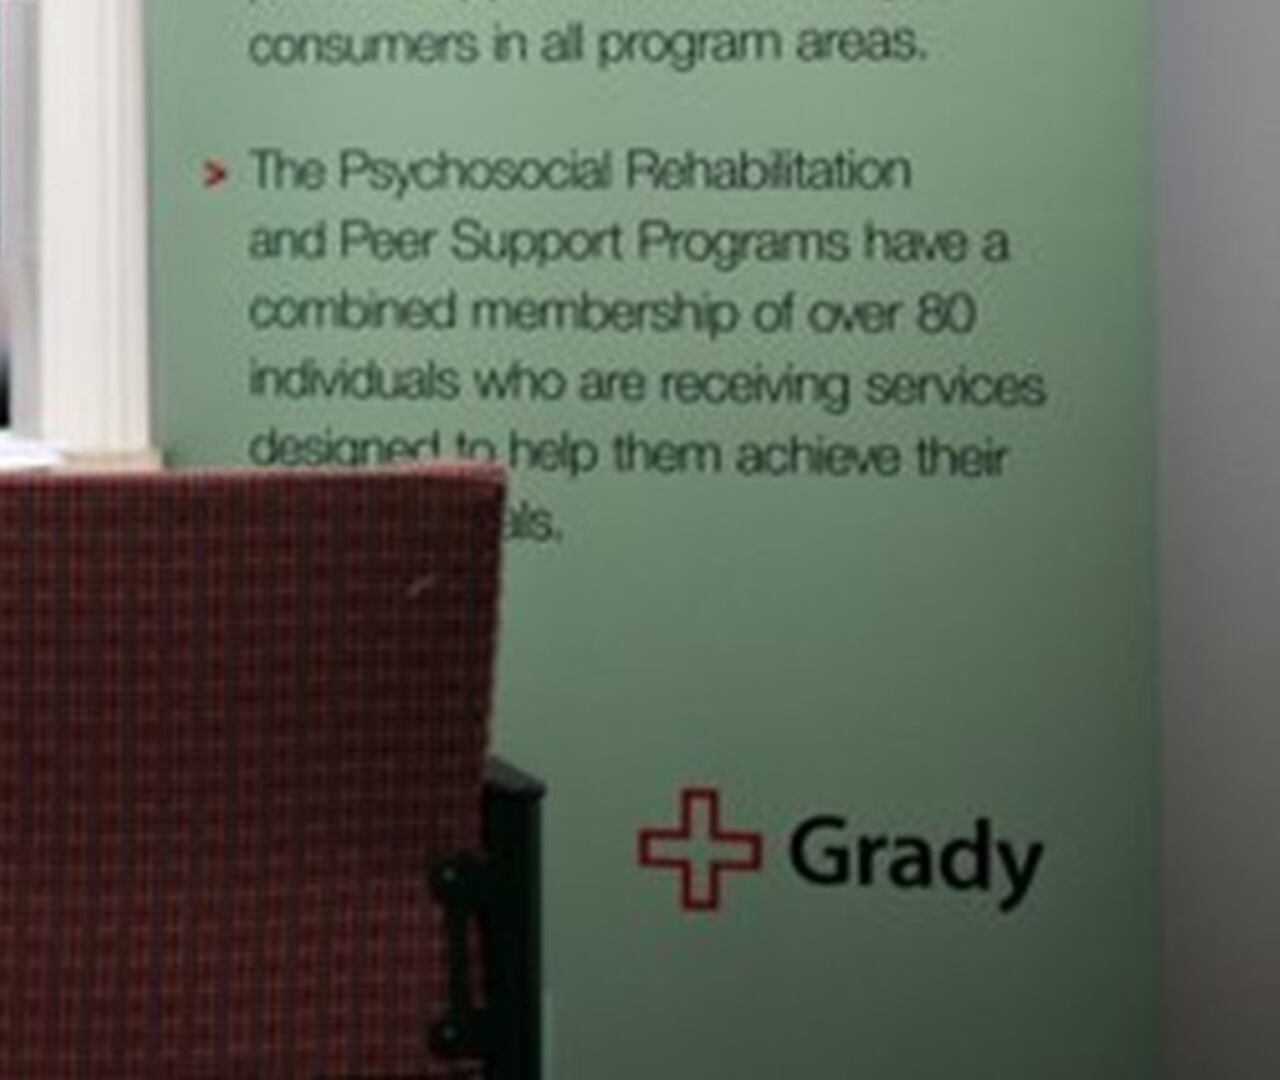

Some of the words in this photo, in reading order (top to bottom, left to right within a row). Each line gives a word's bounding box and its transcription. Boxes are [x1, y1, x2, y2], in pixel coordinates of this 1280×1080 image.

[249, 31, 480, 66] consumers
[493, 23, 528, 62] in
[540, 22, 584, 63] all
[598, 25, 785, 73] program
[797, 25, 928, 63] areas.
[250, 148, 327, 191] The
[339, 148, 612, 199] Psychosocial
[627, 148, 911, 190] Rehabilitation
[249, 221, 327, 260] and
[340, 218, 438, 261] Peer
[450, 217, 623, 268] Support
[638, 218, 851, 272] Programs
[864, 222, 969, 263] have
[982, 229, 1010, 263] a
[249, 289, 457, 330] combined
[471, 290, 741, 340] membership
[752, 291, 795, 333] of
[807, 300, 903, 334] over
[916, 291, 977, 335] 80
[249, 358, 461, 401] individuals
[473, 361, 567, 401] who
[579, 369, 647, 402] are
[660, 363, 851, 415] receiving
[865, 365, 1047, 407] services
[247, 429, 441, 467] designed
[452, 434, 496, 465] to
[509, 430, 599, 479] help
[612, 432, 722, 474] them
[735, 435, 902, 477] achieve
[915, 437, 1009, 478] their
[789, 815, 1044, 913] Grady
